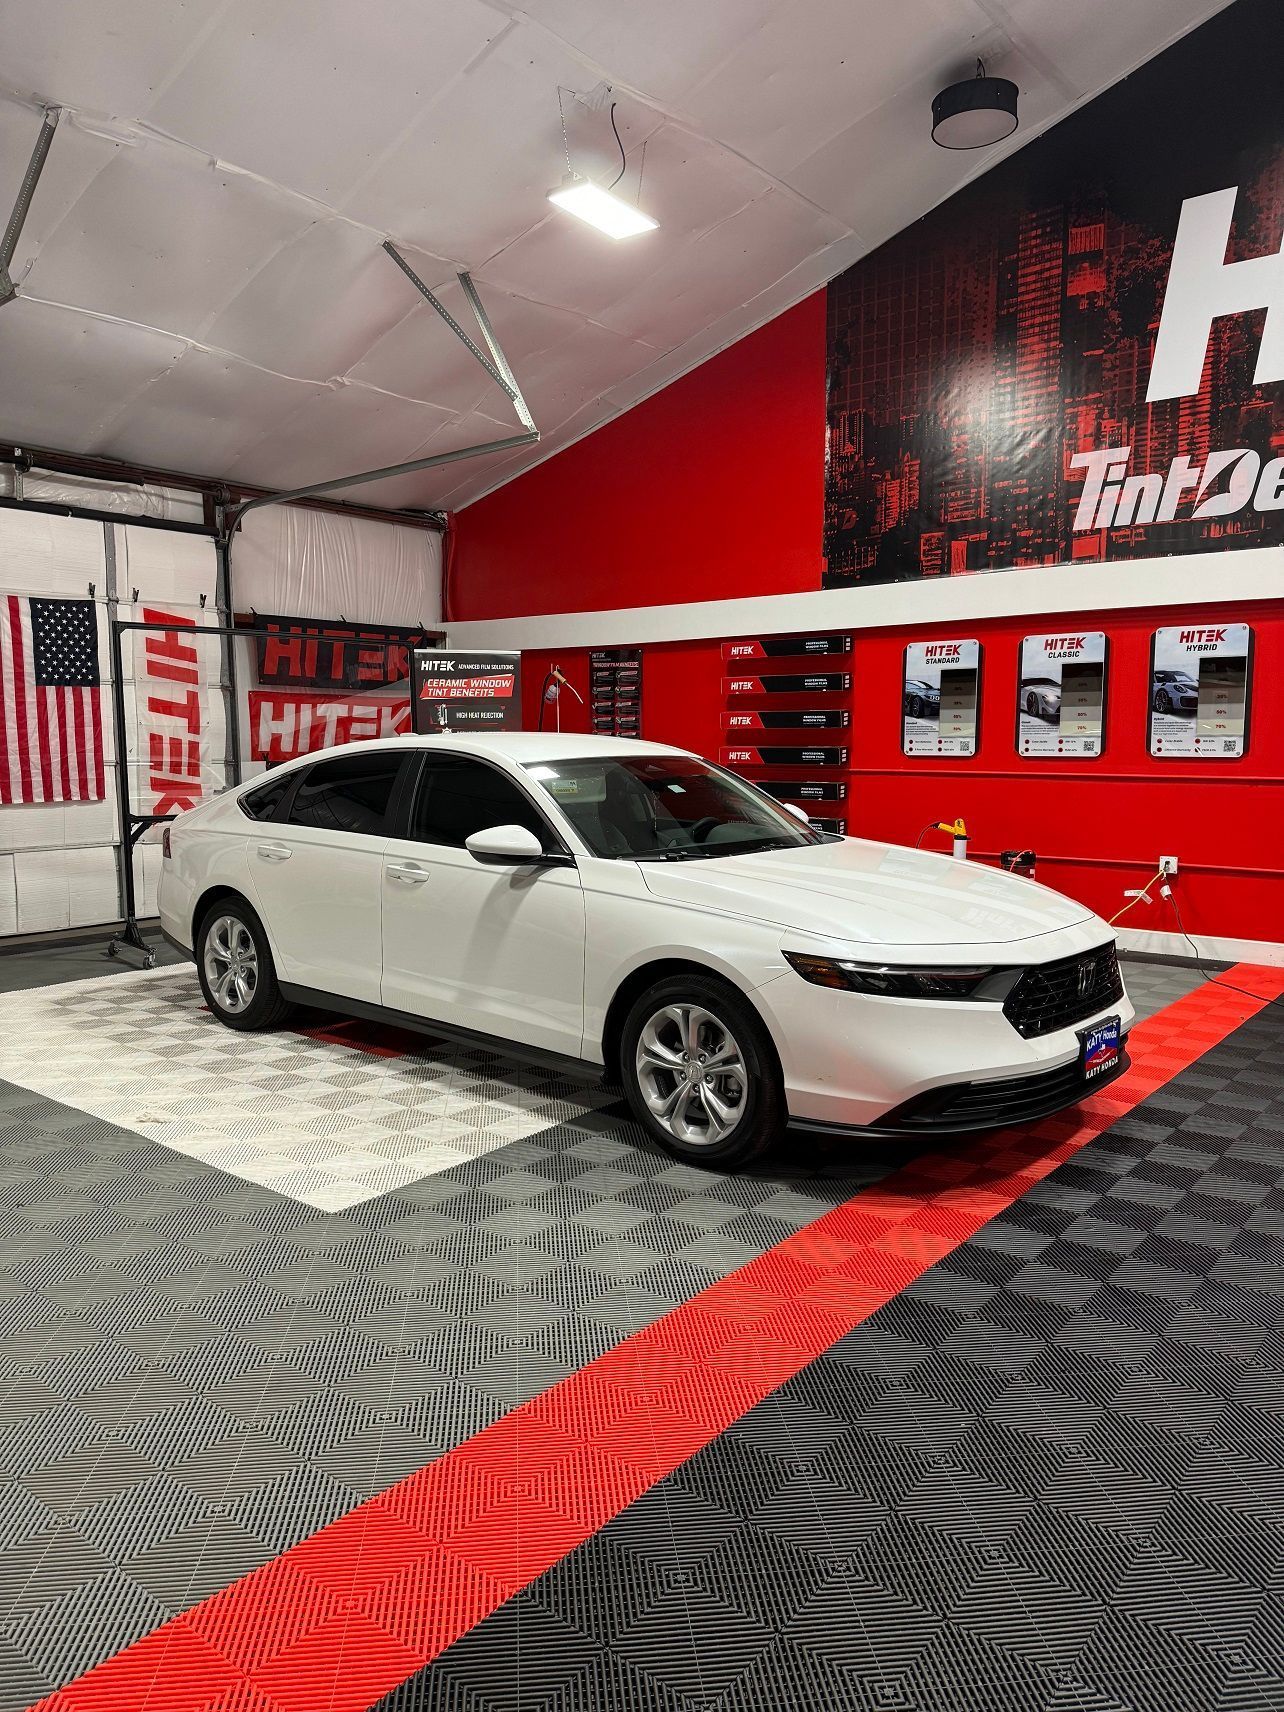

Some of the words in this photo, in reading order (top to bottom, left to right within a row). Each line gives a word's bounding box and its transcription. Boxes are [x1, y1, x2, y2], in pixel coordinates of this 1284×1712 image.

[1179, 629, 1227, 643] HITEK
[1044, 637, 1086, 650] HITEK
[1186, 643, 1218, 652] HYBRID
[263, 623, 427, 682] HITEK
[731, 645, 754, 655] HITEK
[925, 644, 963, 657] HITEK
[1048, 650, 1080, 659] CLASSIC
[421, 660, 456, 671] HITEK
[925, 657, 960, 665] STANDARD
[427, 679, 468, 688] CERAMIC
[470, 679, 512, 688] WINDOW
[731, 681, 754, 690] HITEK
[428, 688, 449, 697] TINT
[450, 688, 495, 697] BENEFITS
[143, 607, 203, 816] HITEK
[729, 716, 752, 725] HITEK
[258, 700, 412, 754] HITEK
[728, 752, 752, 760] HITEK
[1086, 1031, 1103, 1052] KATY
[1102, 1028, 1117, 1040] Honda
[1085, 1065, 1101, 1080] KATY
[1101, 1056, 1119, 1071] HONDA
